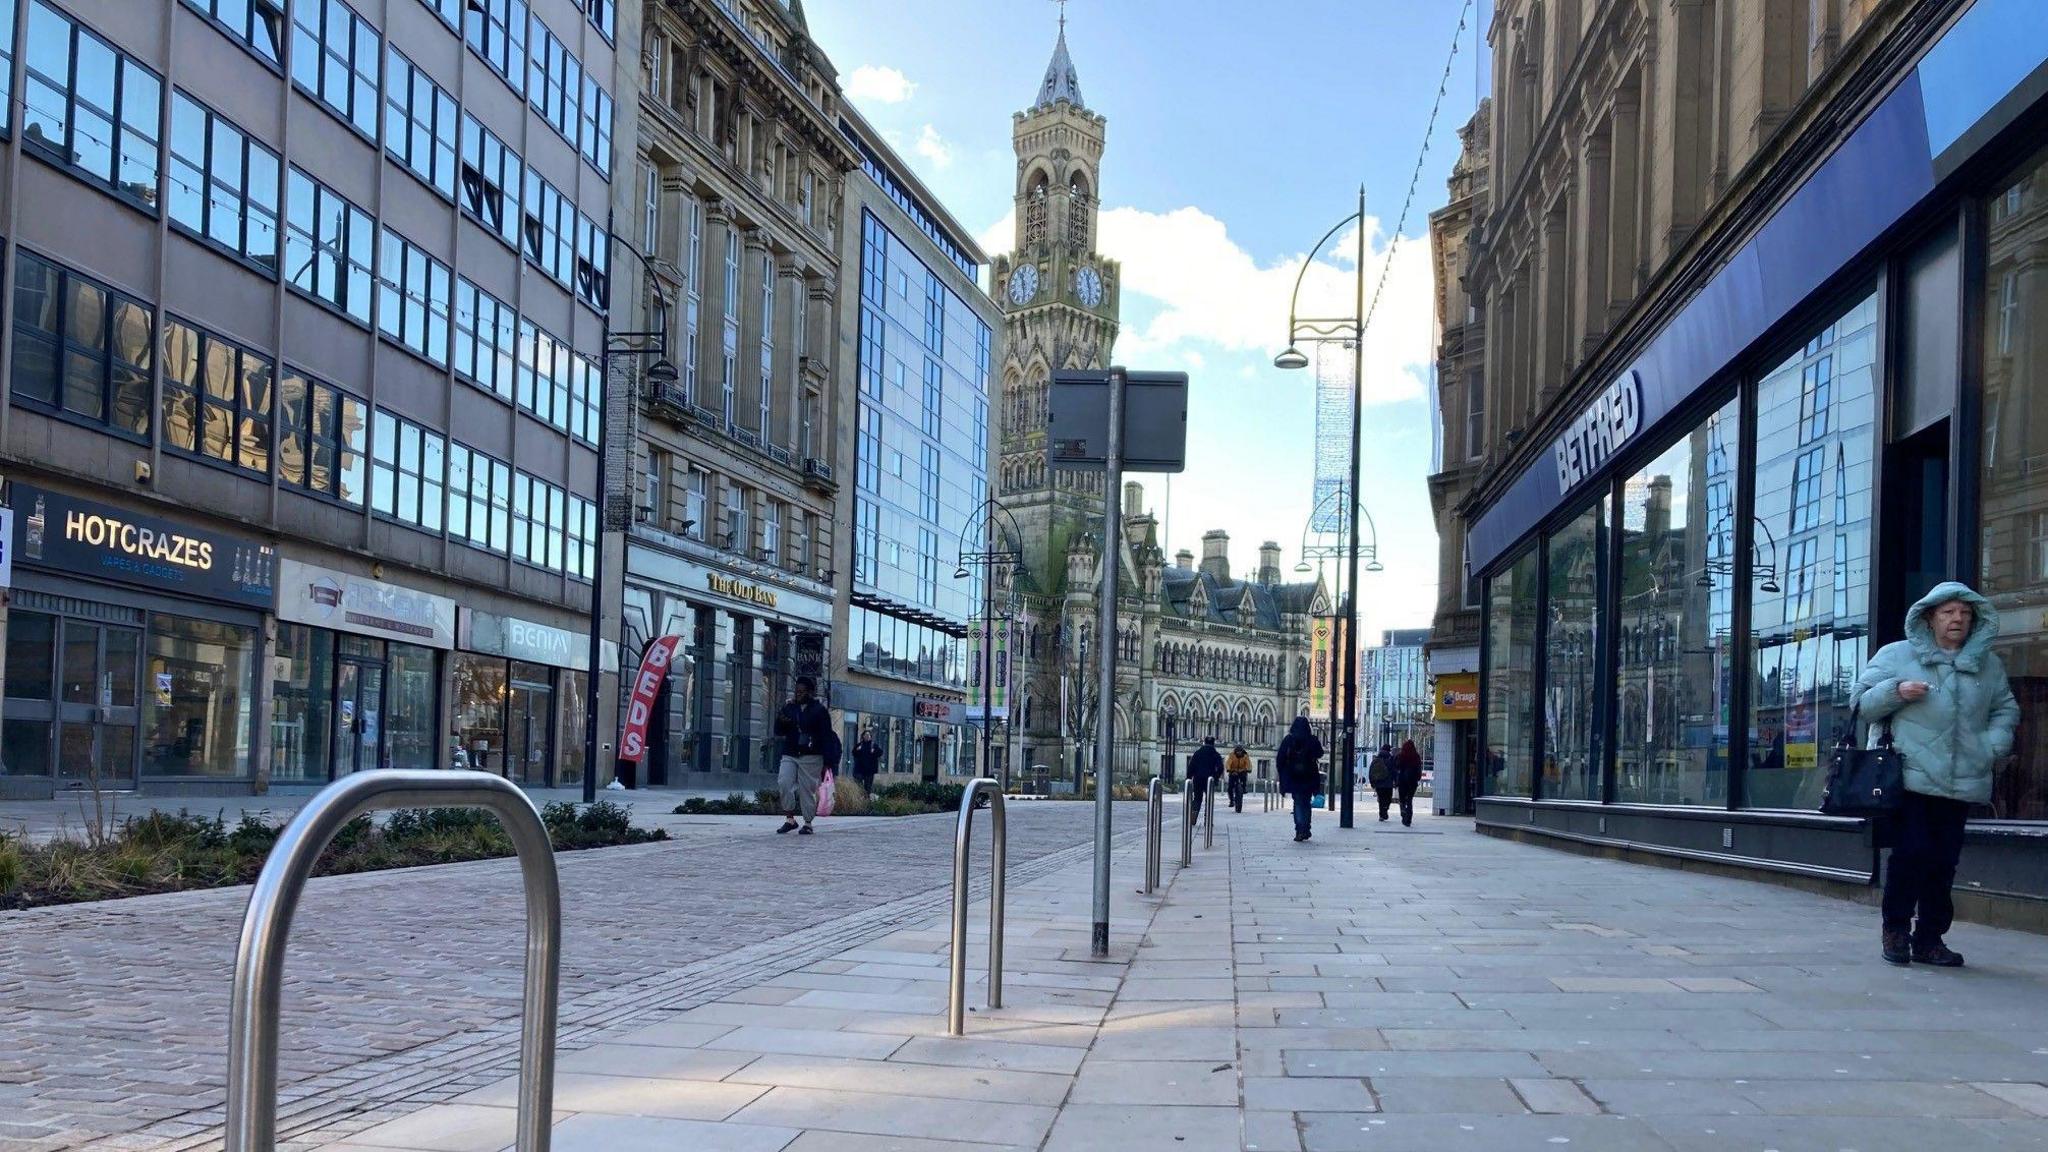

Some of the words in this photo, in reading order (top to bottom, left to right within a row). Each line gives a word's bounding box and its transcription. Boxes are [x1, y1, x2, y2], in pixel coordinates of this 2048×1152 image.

[1554, 369, 1639, 496] BETFRED
[66, 510, 213, 570] HOTCRAZES
[101, 555, 132, 572] VAPES
[143, 563, 184, 582] GADGETS
[711, 574, 731, 594] THE
[734, 579, 753, 600] OLD
[755, 585, 777, 606] BANK
[623, 641, 670, 756] BEDS
